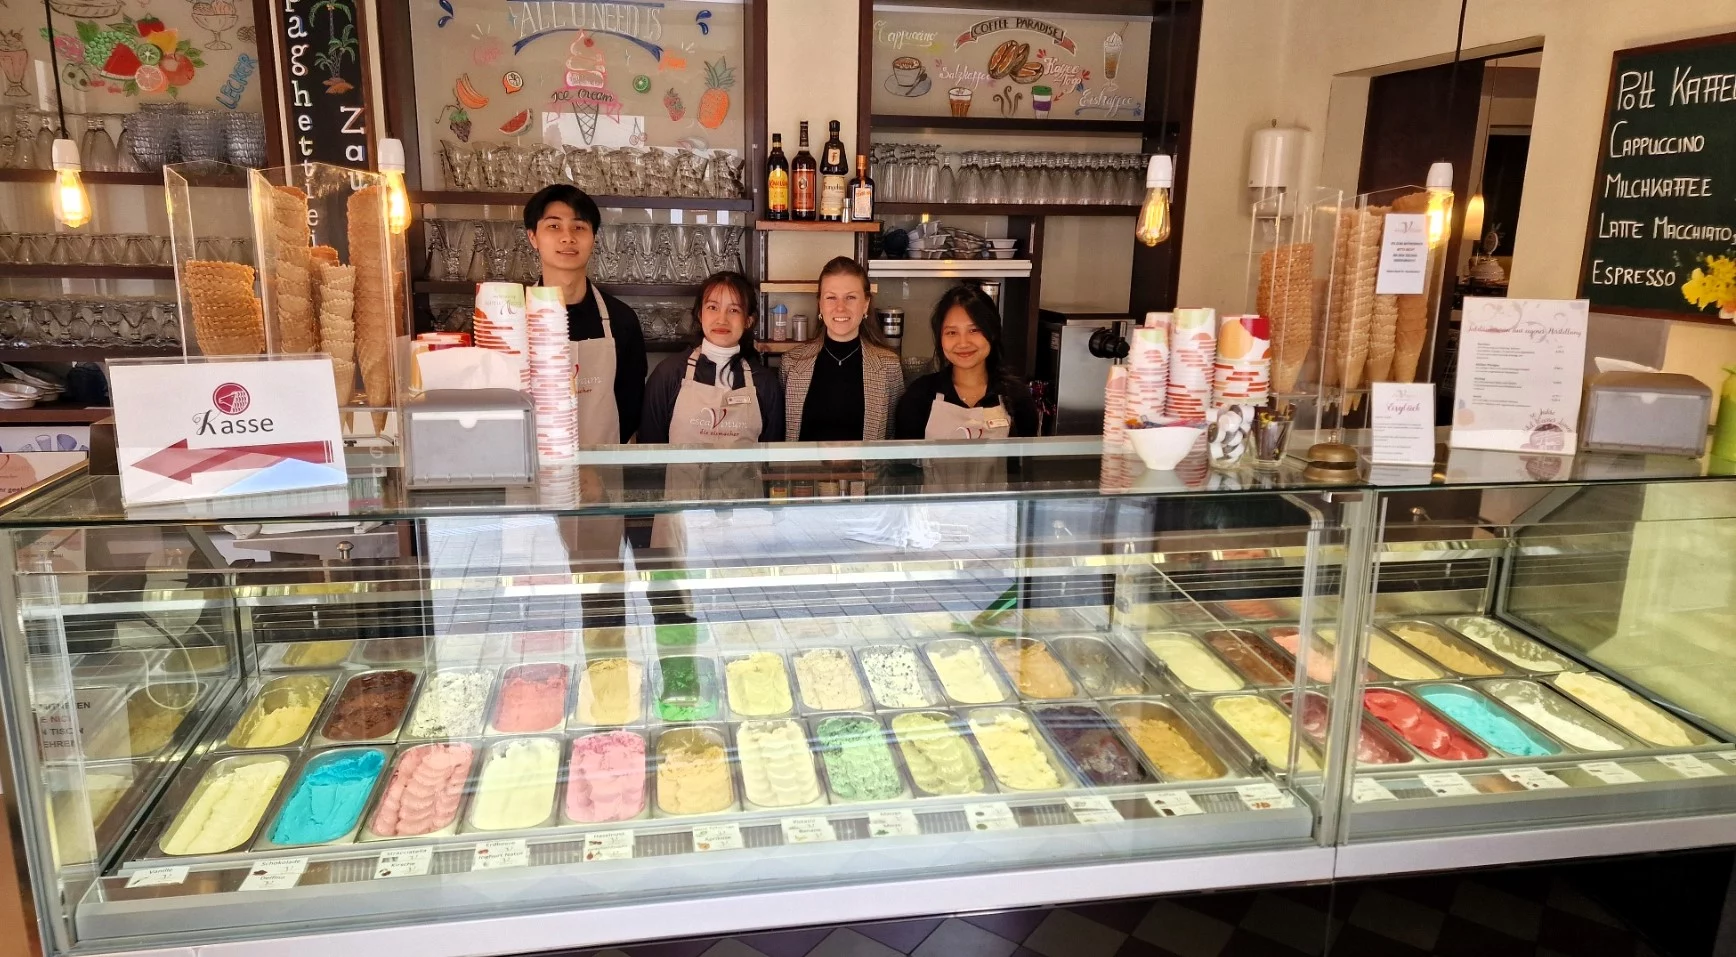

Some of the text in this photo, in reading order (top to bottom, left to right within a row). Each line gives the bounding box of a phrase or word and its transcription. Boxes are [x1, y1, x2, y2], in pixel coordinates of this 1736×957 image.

[520, 1, 566, 38] ALL
[569, 2, 586, 28] U
[592, 3, 640, 38] NEED
[973, 18, 1009, 36] COFFEE
[939, 64, 991, 90] Salzkaffee
[1043, 57, 1080, 78] Kaffee
[215, 53, 257, 109] LECKER
[1617, 66, 1736, 111] Pott KAFFE
[551, 88, 615, 103] Ice Cream
[1610, 120, 1705, 157] CAPPUCCINO
[1605, 173, 1713, 199] MILCHKAFFEE
[1599, 212, 1645, 239] LATTE
[1592, 260, 1676, 287] ESPRESSO
[192, 410, 274, 436] Kasse
